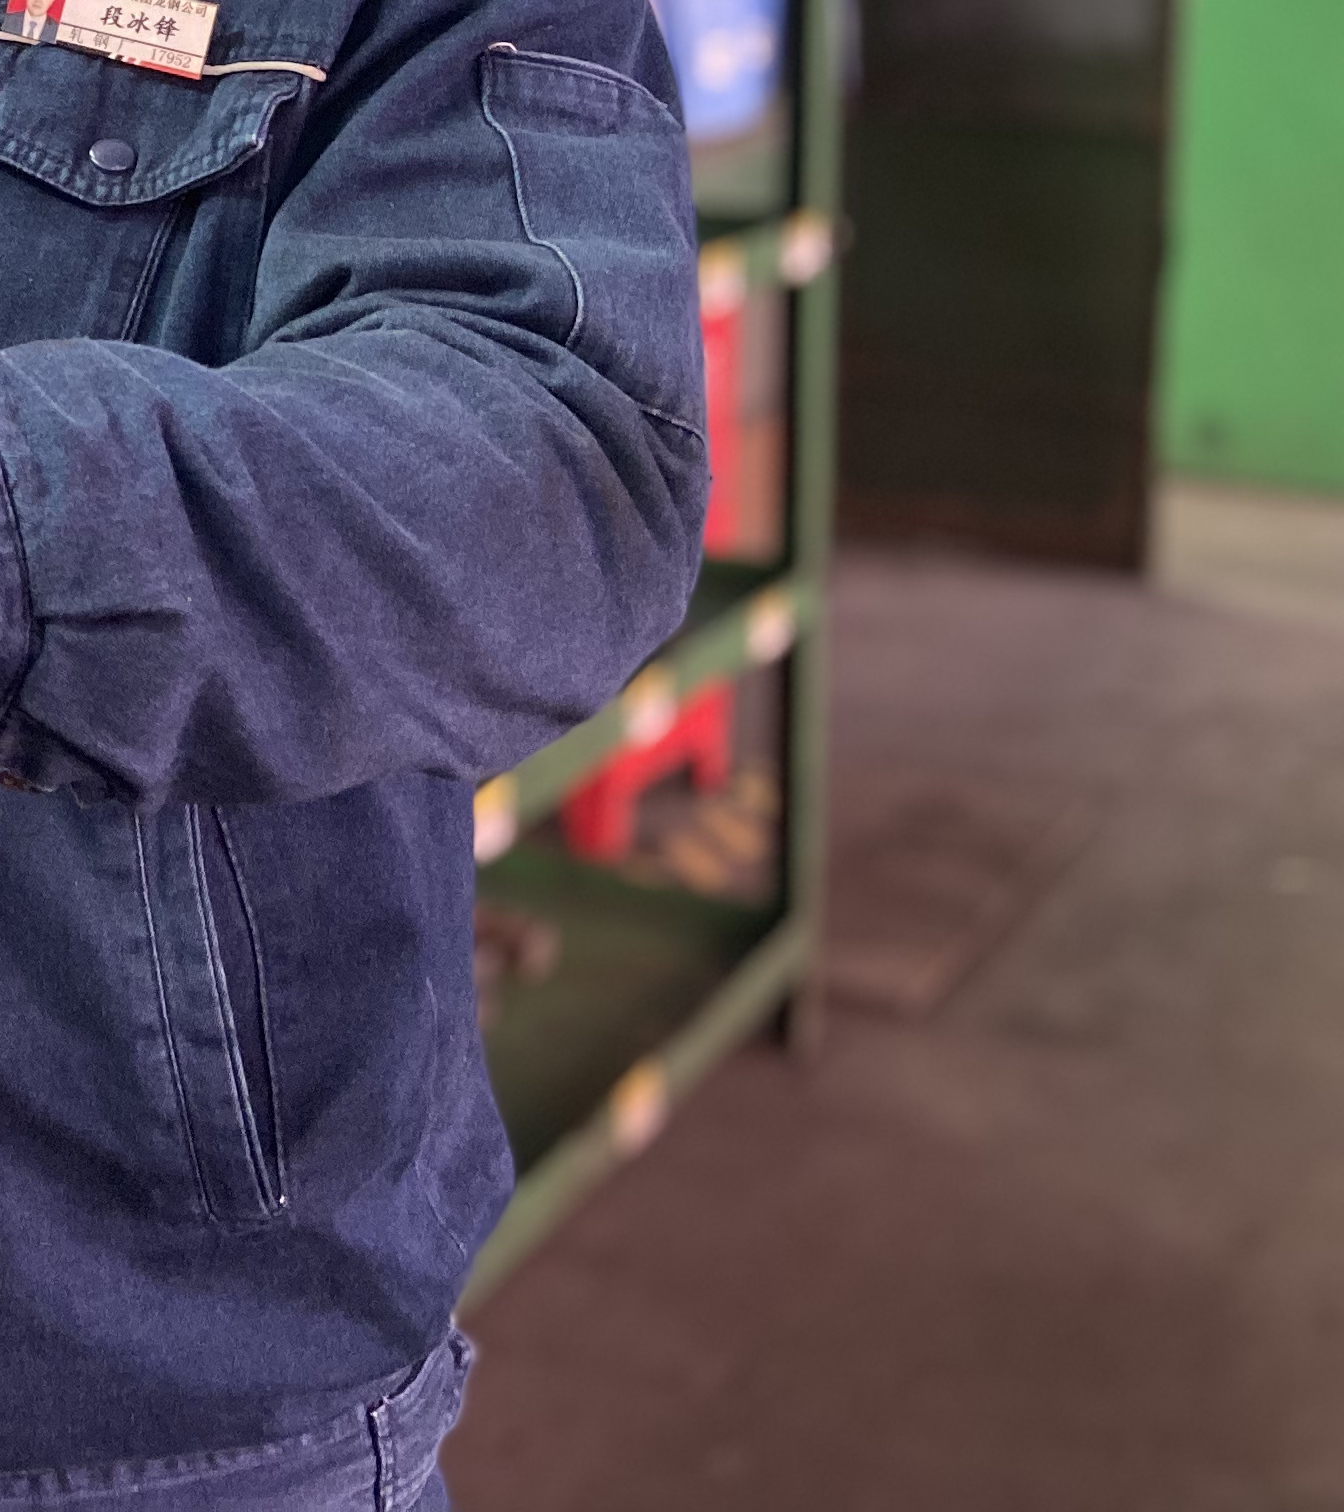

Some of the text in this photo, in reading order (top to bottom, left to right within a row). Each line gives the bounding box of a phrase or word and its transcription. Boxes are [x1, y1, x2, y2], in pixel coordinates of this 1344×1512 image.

[100, 5, 181, 43] 段冰锋
[150, 48, 193, 69] 17952
